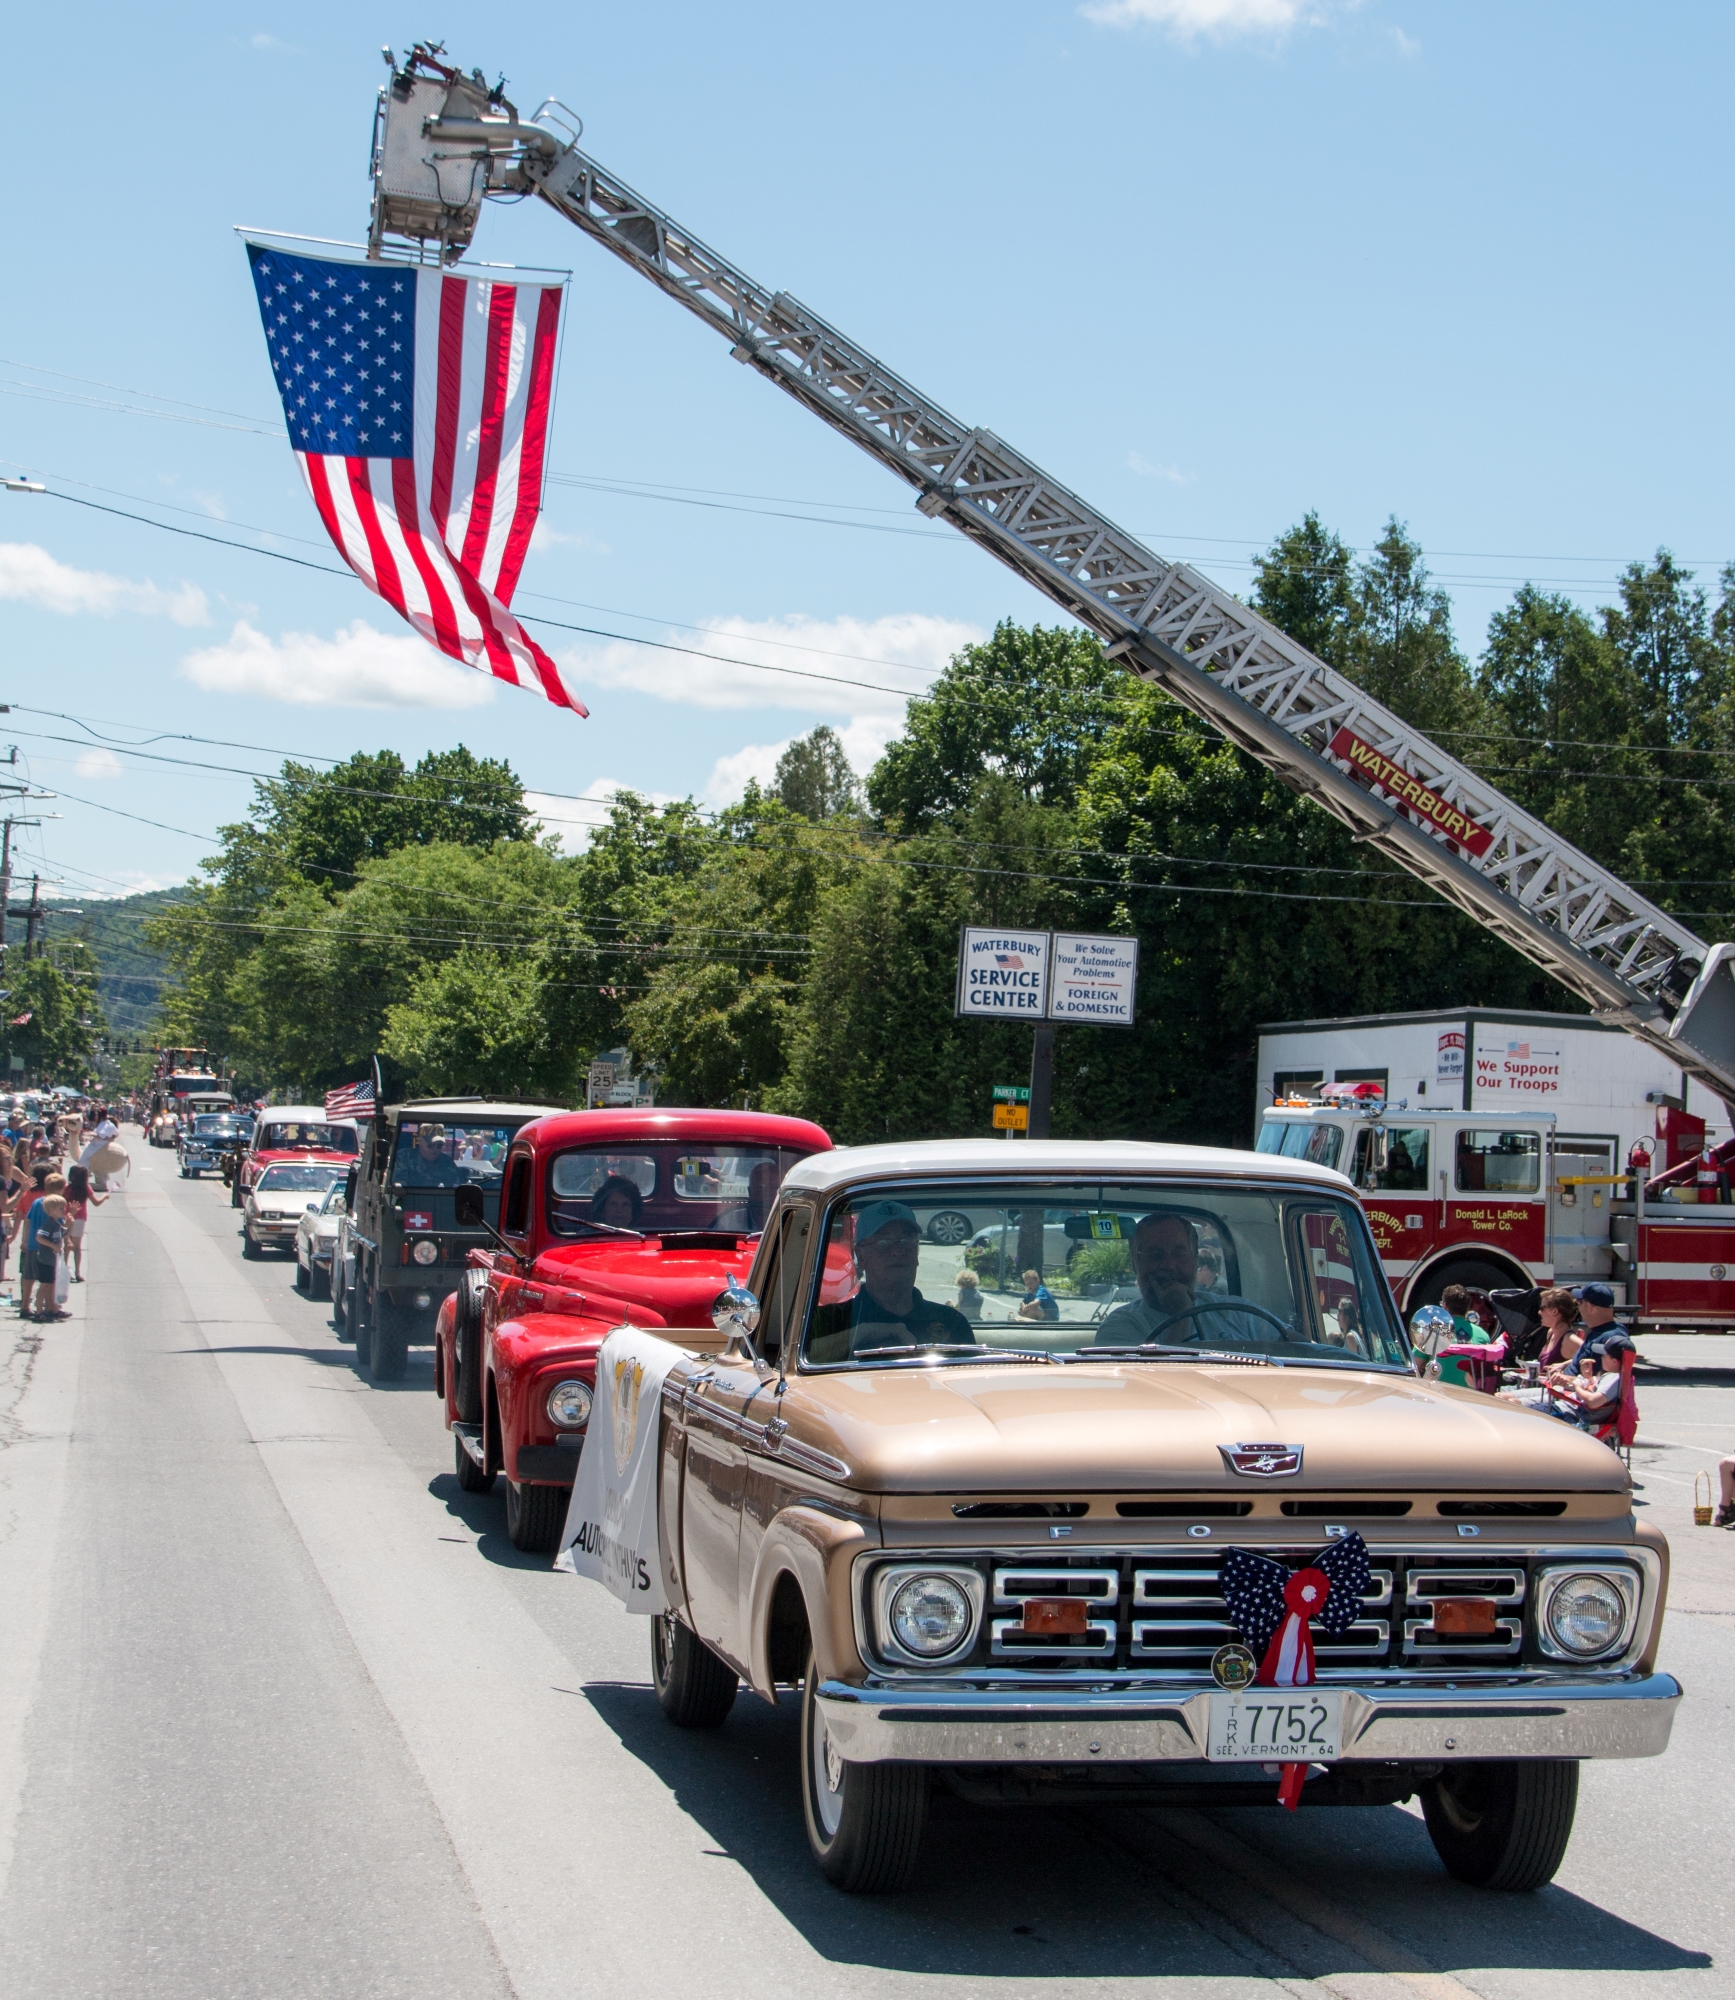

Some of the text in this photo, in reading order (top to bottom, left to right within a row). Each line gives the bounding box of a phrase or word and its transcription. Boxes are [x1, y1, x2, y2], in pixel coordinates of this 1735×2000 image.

[1350, 739, 1480, 842] WATERBURY
[972, 940, 1041, 957] WATERBURY
[1075, 944, 1116, 955] We Solve
[1057, 955, 1132, 968] Your Automotive
[970, 969, 1040, 987] SERVICE
[1073, 968, 1115, 979] Problems
[970, 990, 1039, 1009] CENTER
[1068, 989, 1118, 1001] FOREIGN
[1055, 1001, 1127, 1015] & DOMESTIC
[1476, 1060, 1559, 1077] We Support
[592, 1076, 611, 1087] 25
[1476, 1075, 1558, 1093] Our Troops
[994, 1088, 1030, 1099] PARKER CT
[997, 1118, 1023, 1126] OUTLET
[1455, 1209, 1528, 1220] Donald L. LaRock
[1098, 1221, 1112, 1231] 10
[1365, 1211, 1405, 1234] ERBURY
[1472, 1220, 1513, 1231] Tower Co.
[1049, 1525, 1481, 1538] FORD
[1245, 1704, 1328, 1744] 7752
[1242, 1745, 1307, 1755] VERMONT
[1319, 1745, 1334, 1755] 64
